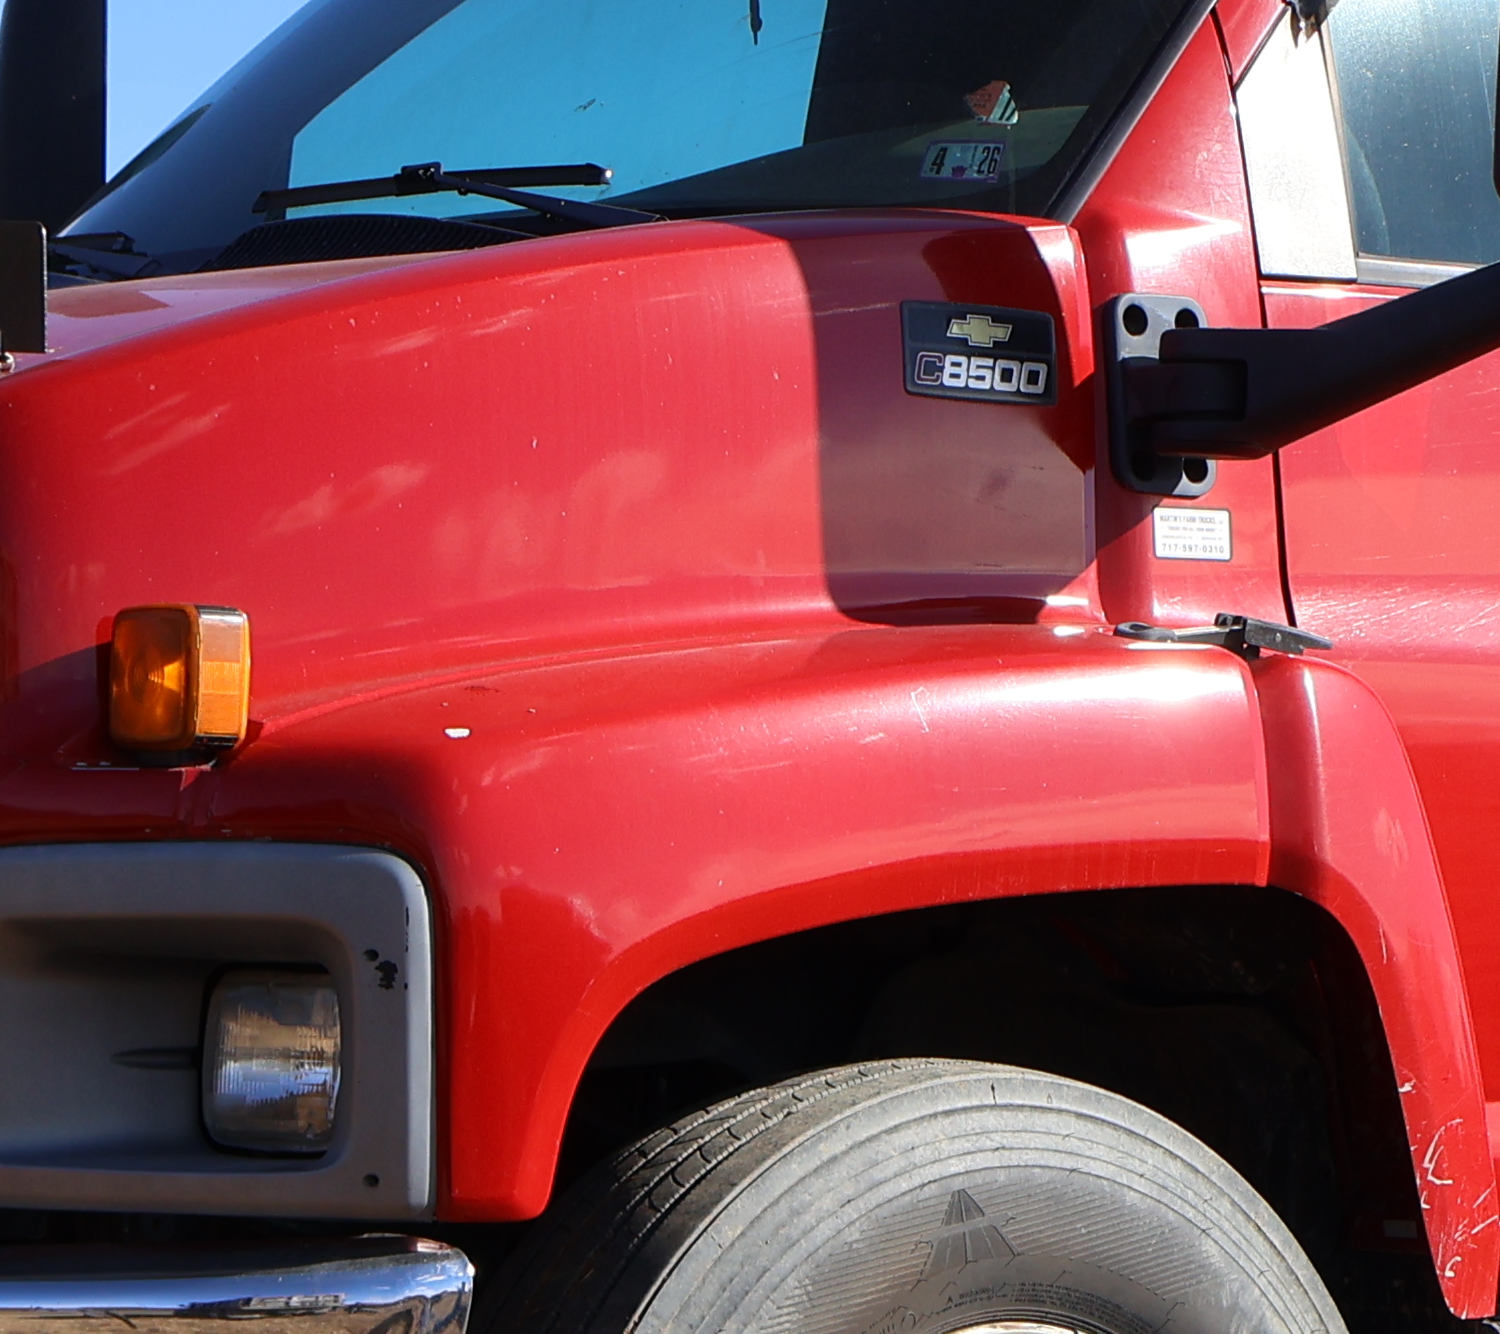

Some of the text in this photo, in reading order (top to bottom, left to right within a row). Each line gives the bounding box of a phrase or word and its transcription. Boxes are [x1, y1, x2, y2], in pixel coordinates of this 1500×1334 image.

[931, 145, 1001, 175] 4 26
[914, 351, 1048, 394] C8500
